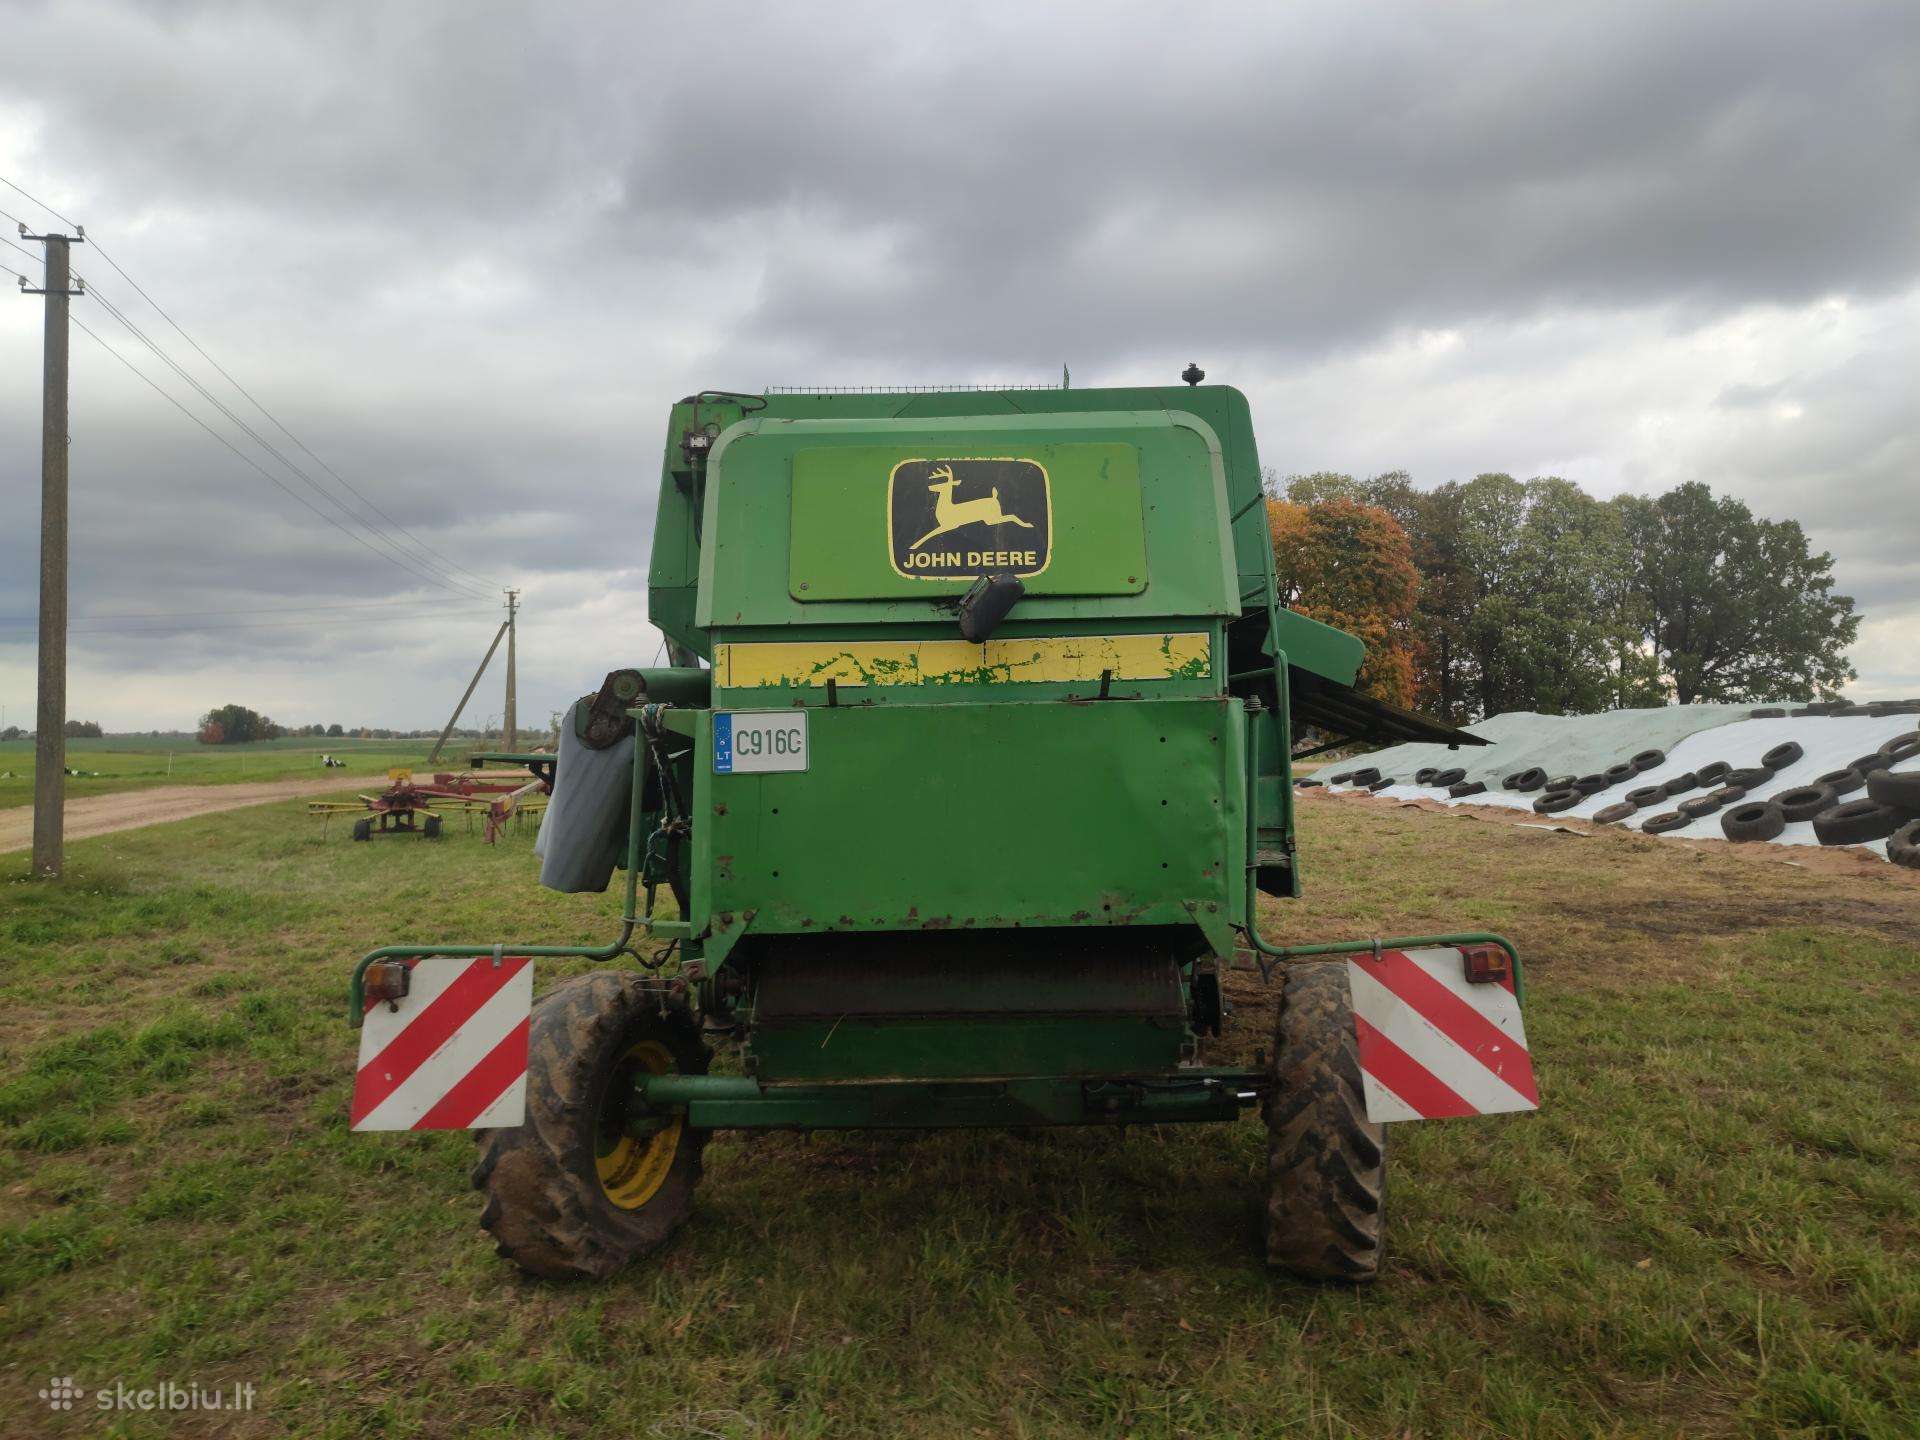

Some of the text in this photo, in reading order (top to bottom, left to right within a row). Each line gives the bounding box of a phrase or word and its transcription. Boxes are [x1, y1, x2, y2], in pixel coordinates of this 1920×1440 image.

[904, 550, 1037, 569] JOHN DEERE
[736, 728, 801, 755] C916C
[716, 751, 731, 760] LT
